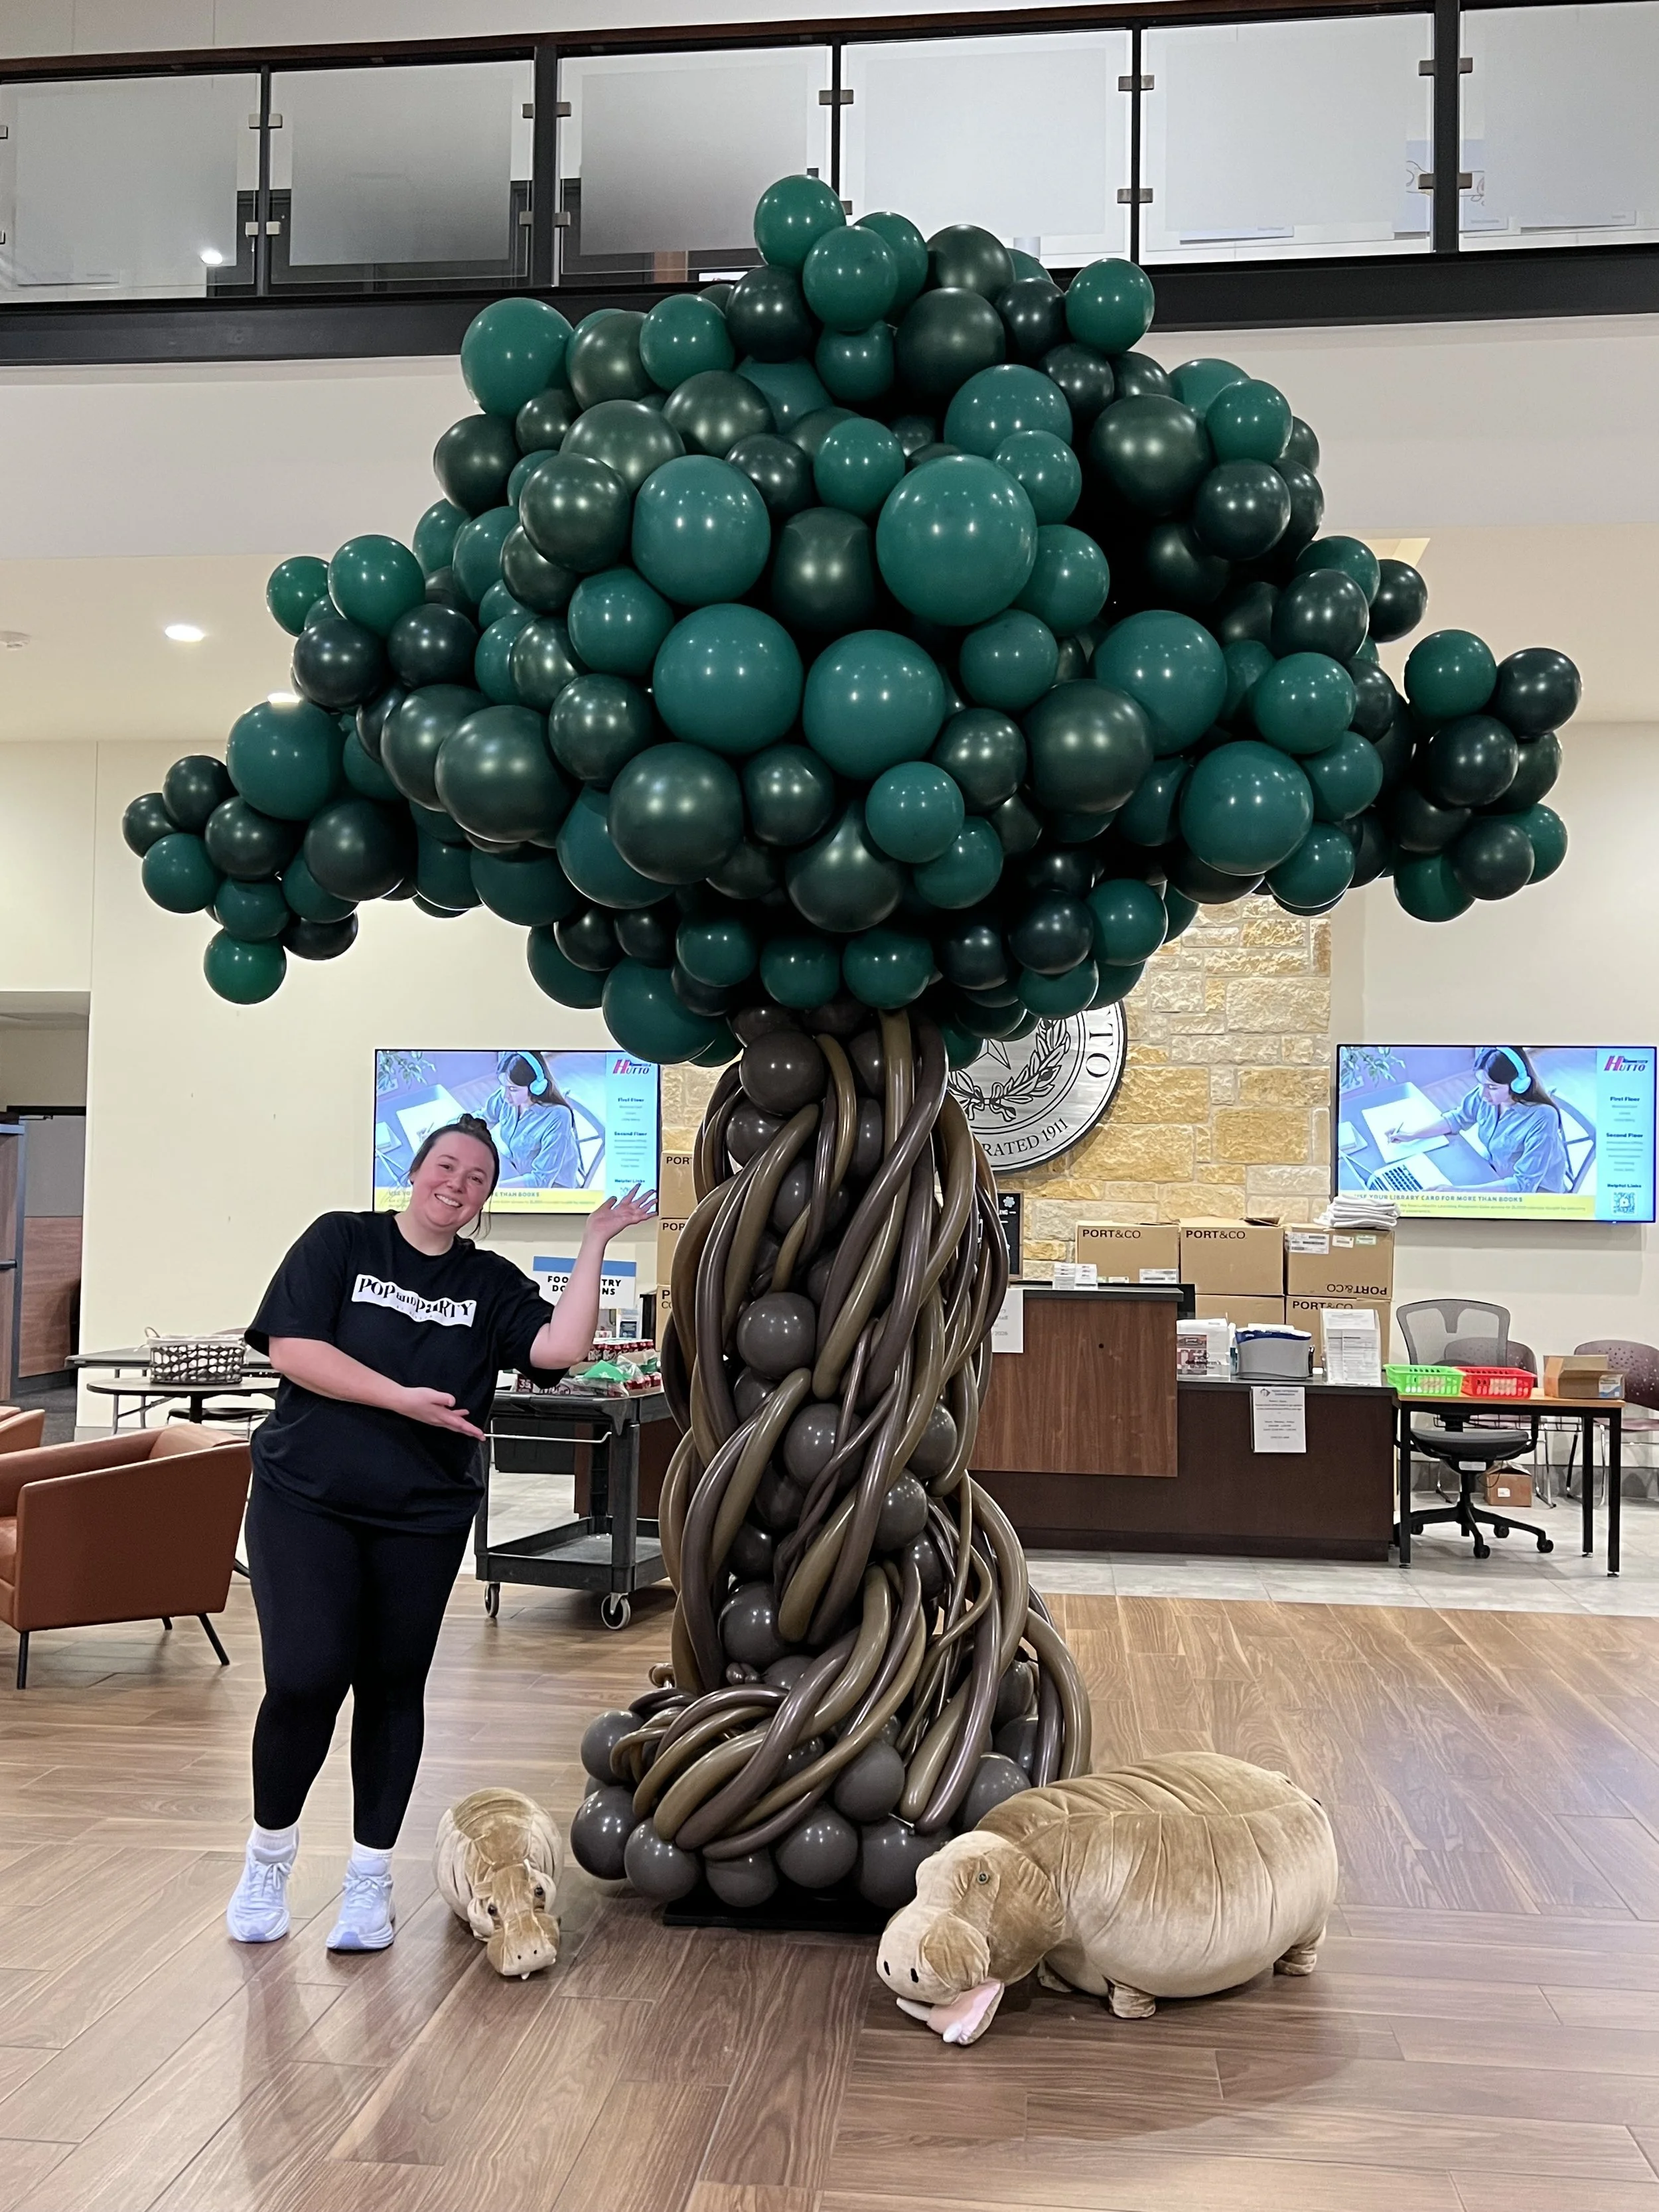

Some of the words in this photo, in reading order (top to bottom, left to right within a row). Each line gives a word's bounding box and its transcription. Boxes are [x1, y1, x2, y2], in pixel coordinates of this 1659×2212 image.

[982, 1134, 1039, 1156] RATED
[1042, 1118, 1068, 1142] 1911
[358, 1278, 396, 1299] POP
